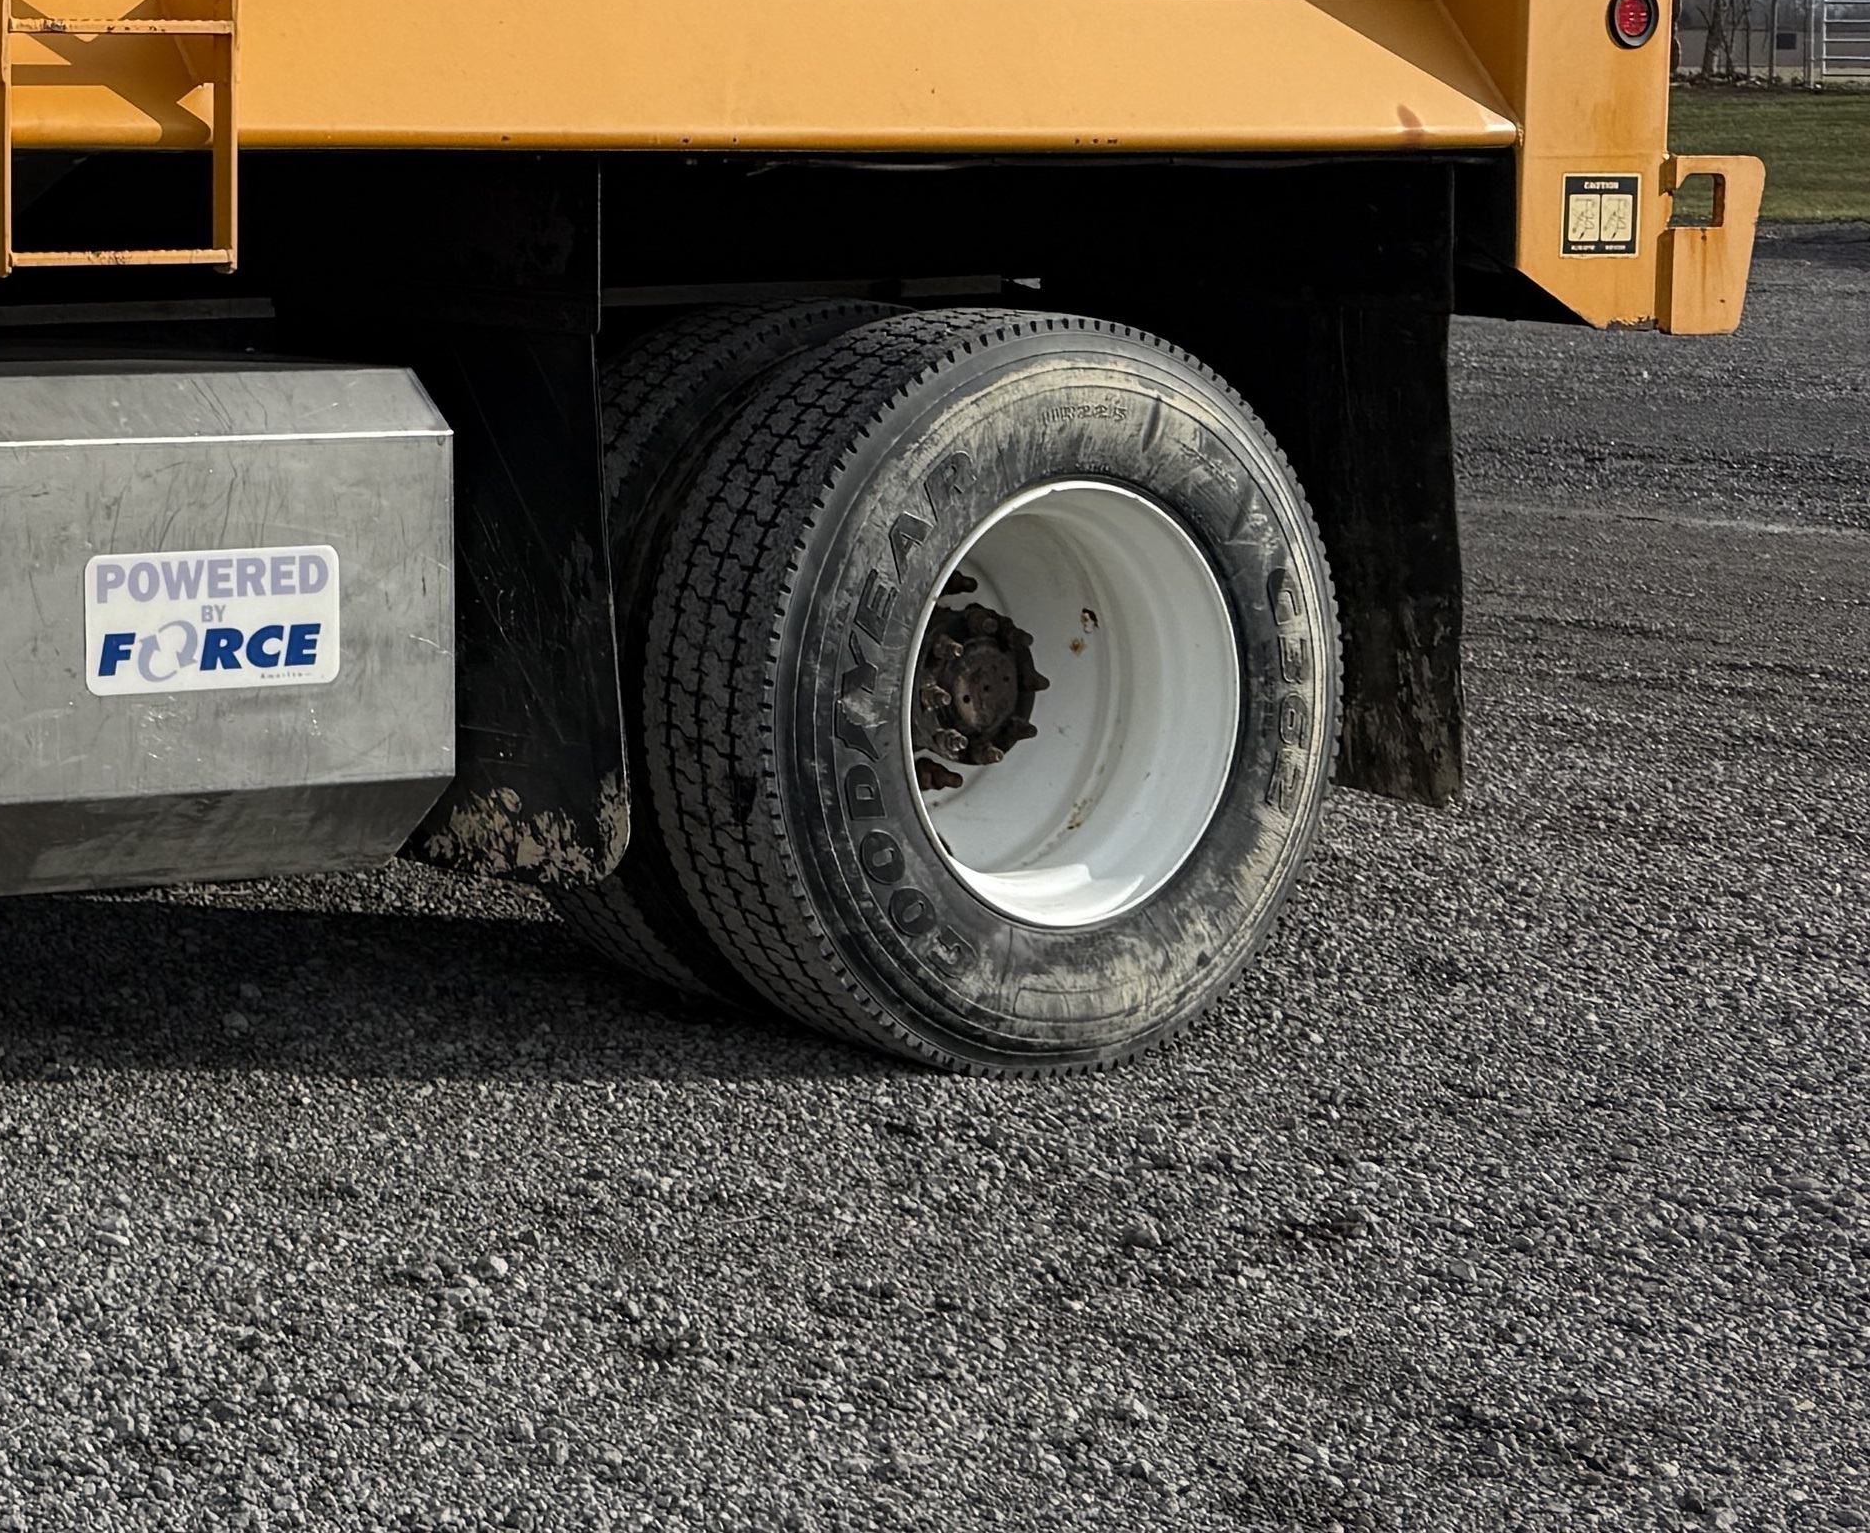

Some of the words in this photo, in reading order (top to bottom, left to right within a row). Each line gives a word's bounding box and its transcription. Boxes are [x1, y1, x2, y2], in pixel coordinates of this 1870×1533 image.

[96, 555, 329, 604] POWERED
[201, 604, 227, 623] BY
[98, 620, 321, 682] FORCE
[834, 448, 983, 979] GOODYEAR
